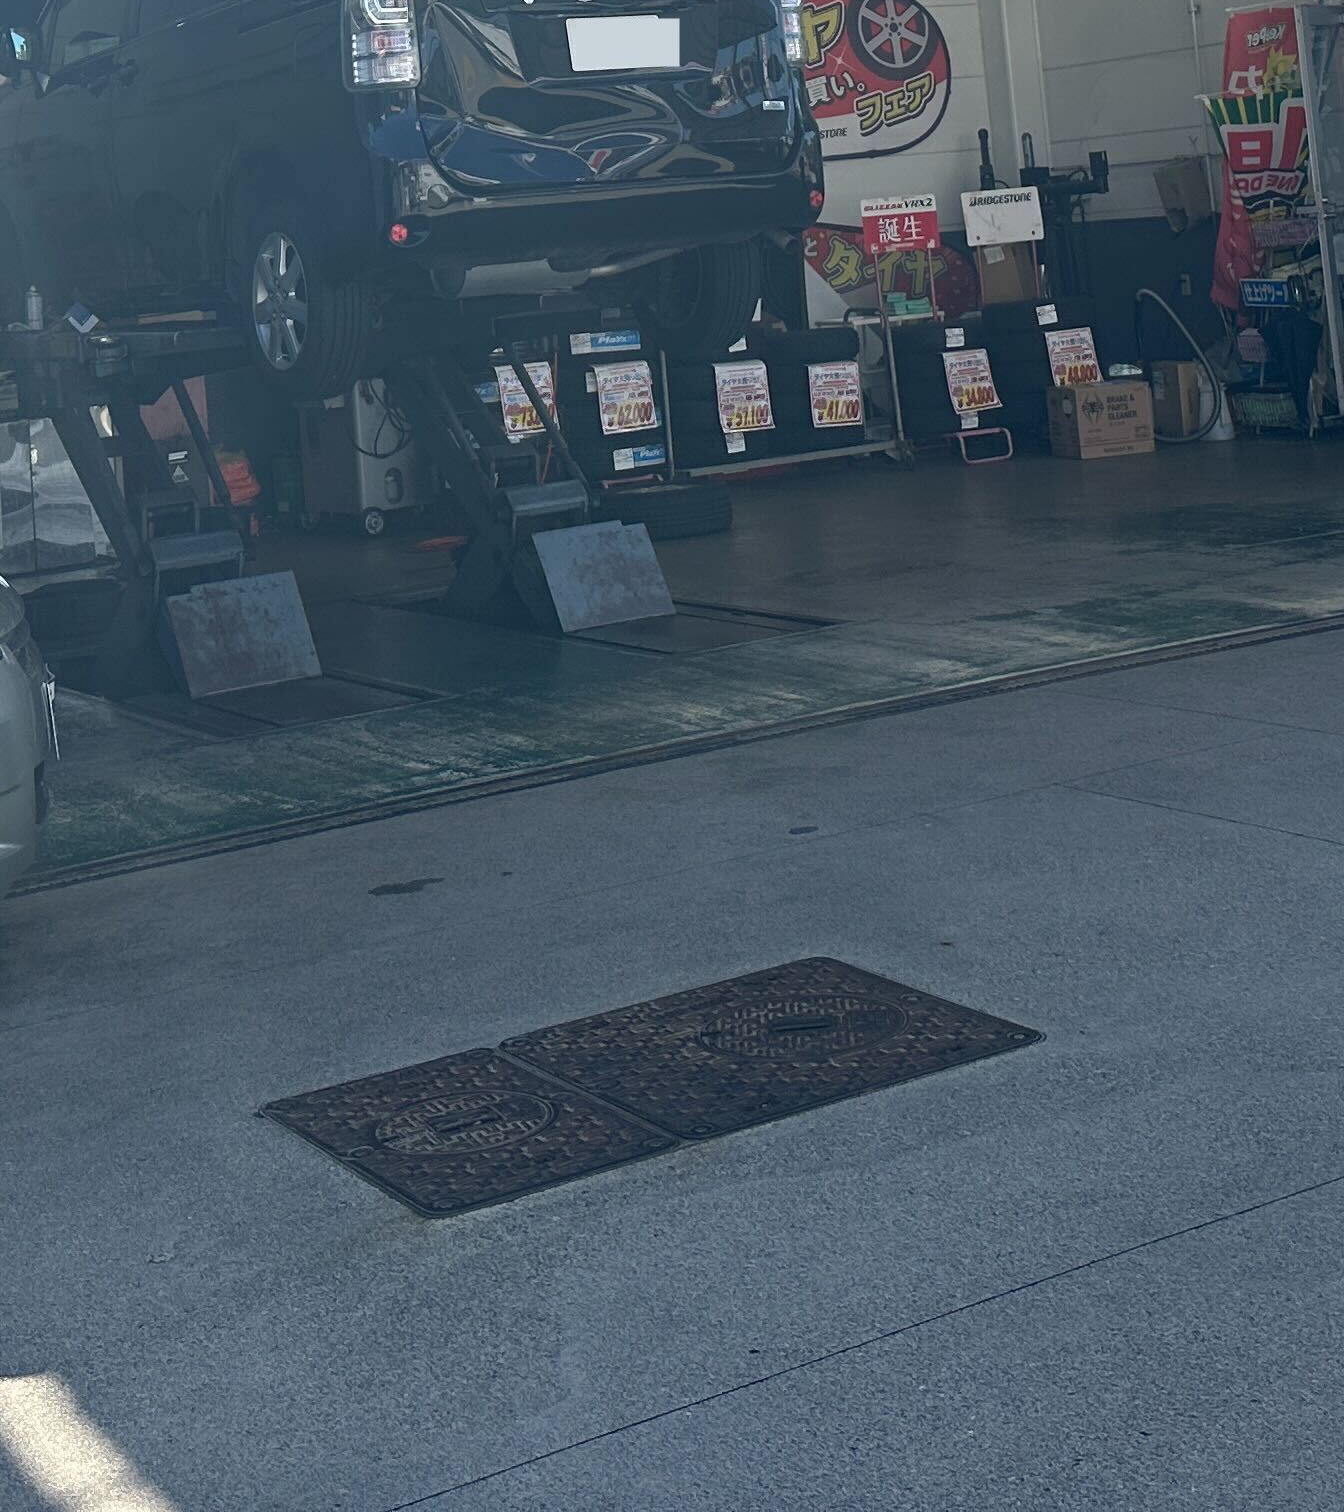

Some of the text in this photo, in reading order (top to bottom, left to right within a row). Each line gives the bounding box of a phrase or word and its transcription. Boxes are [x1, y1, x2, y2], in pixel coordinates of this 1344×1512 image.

[855, 71, 935, 136] フェア
[968, 192, 1032, 207] BRIDGESTONE
[877, 216, 924, 243] 誕生
